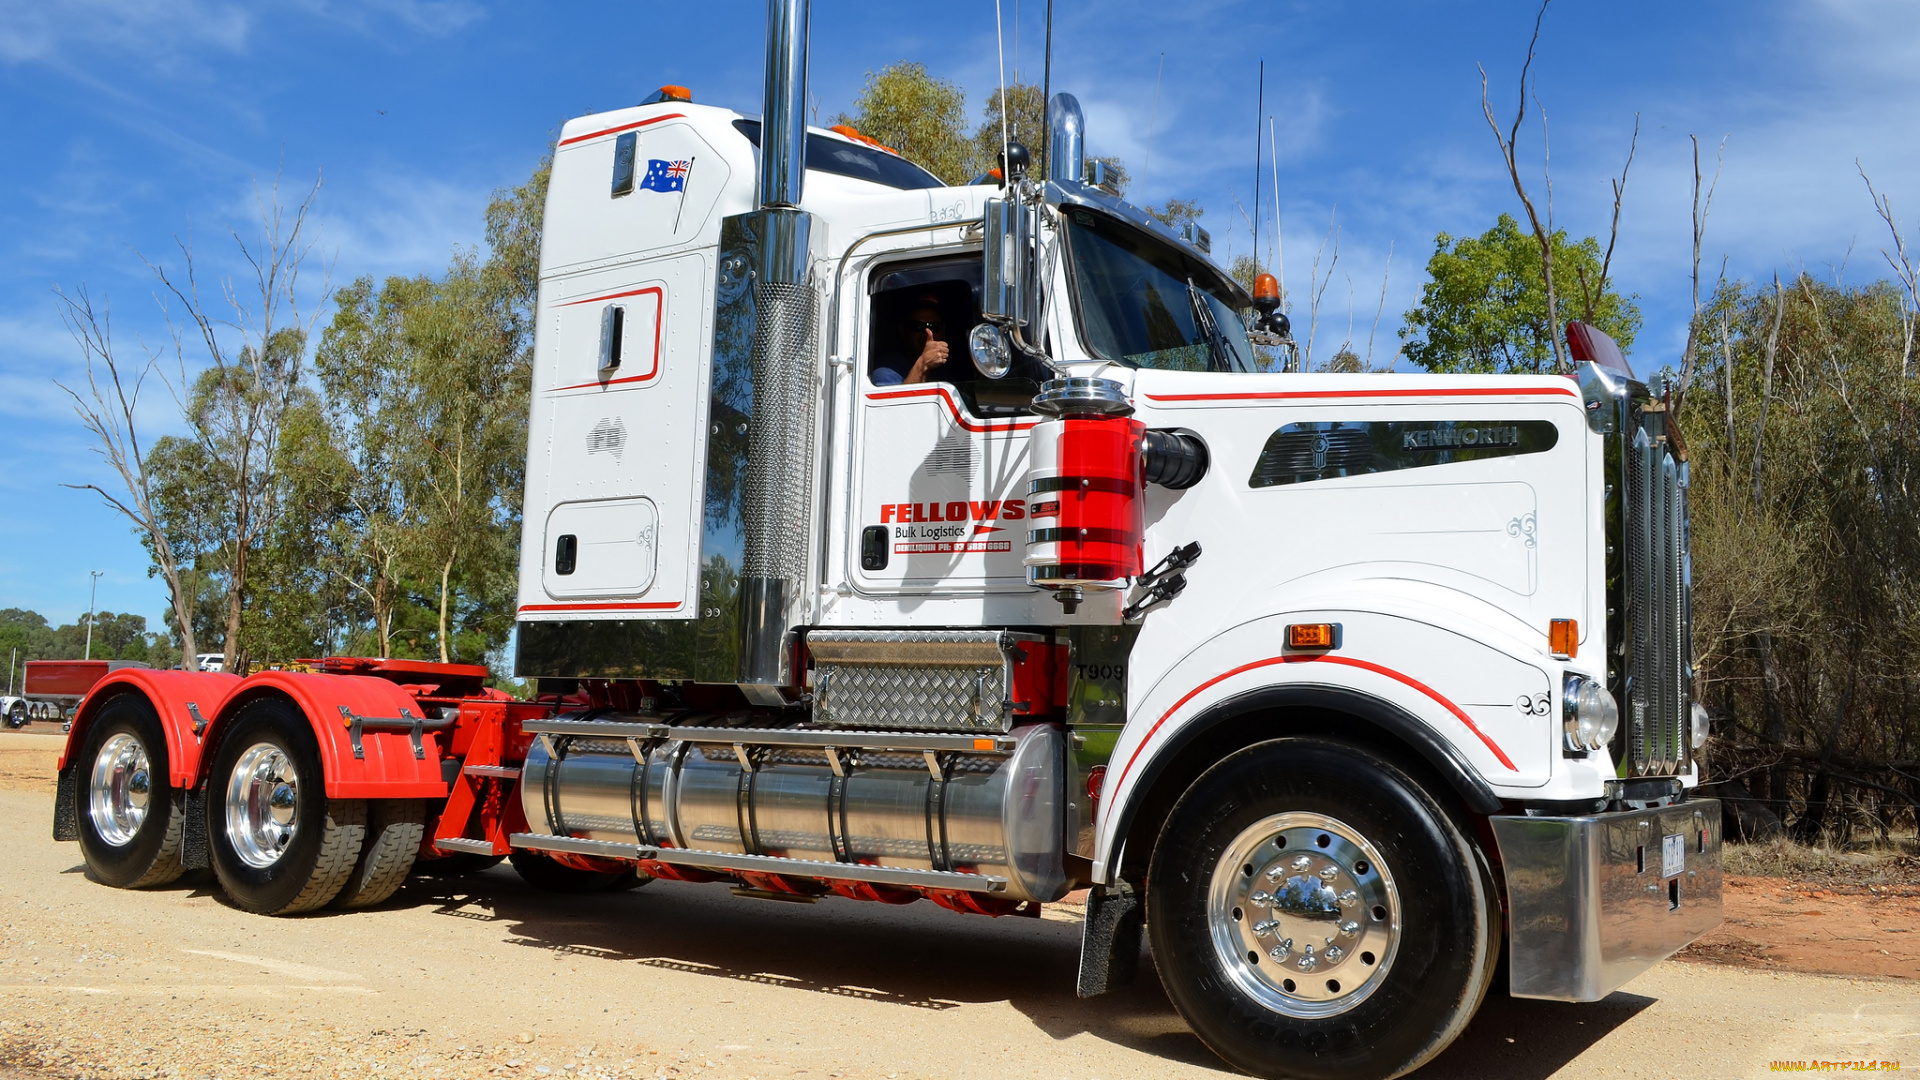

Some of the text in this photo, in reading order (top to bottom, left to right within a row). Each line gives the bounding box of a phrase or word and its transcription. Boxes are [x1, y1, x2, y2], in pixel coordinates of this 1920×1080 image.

[1403, 426, 1518, 447] KENWORTH
[880, 499, 1026, 524] FELLOWS
[895, 525, 965, 540] Bulk Logistics
[1076, 664, 1124, 680] T909
